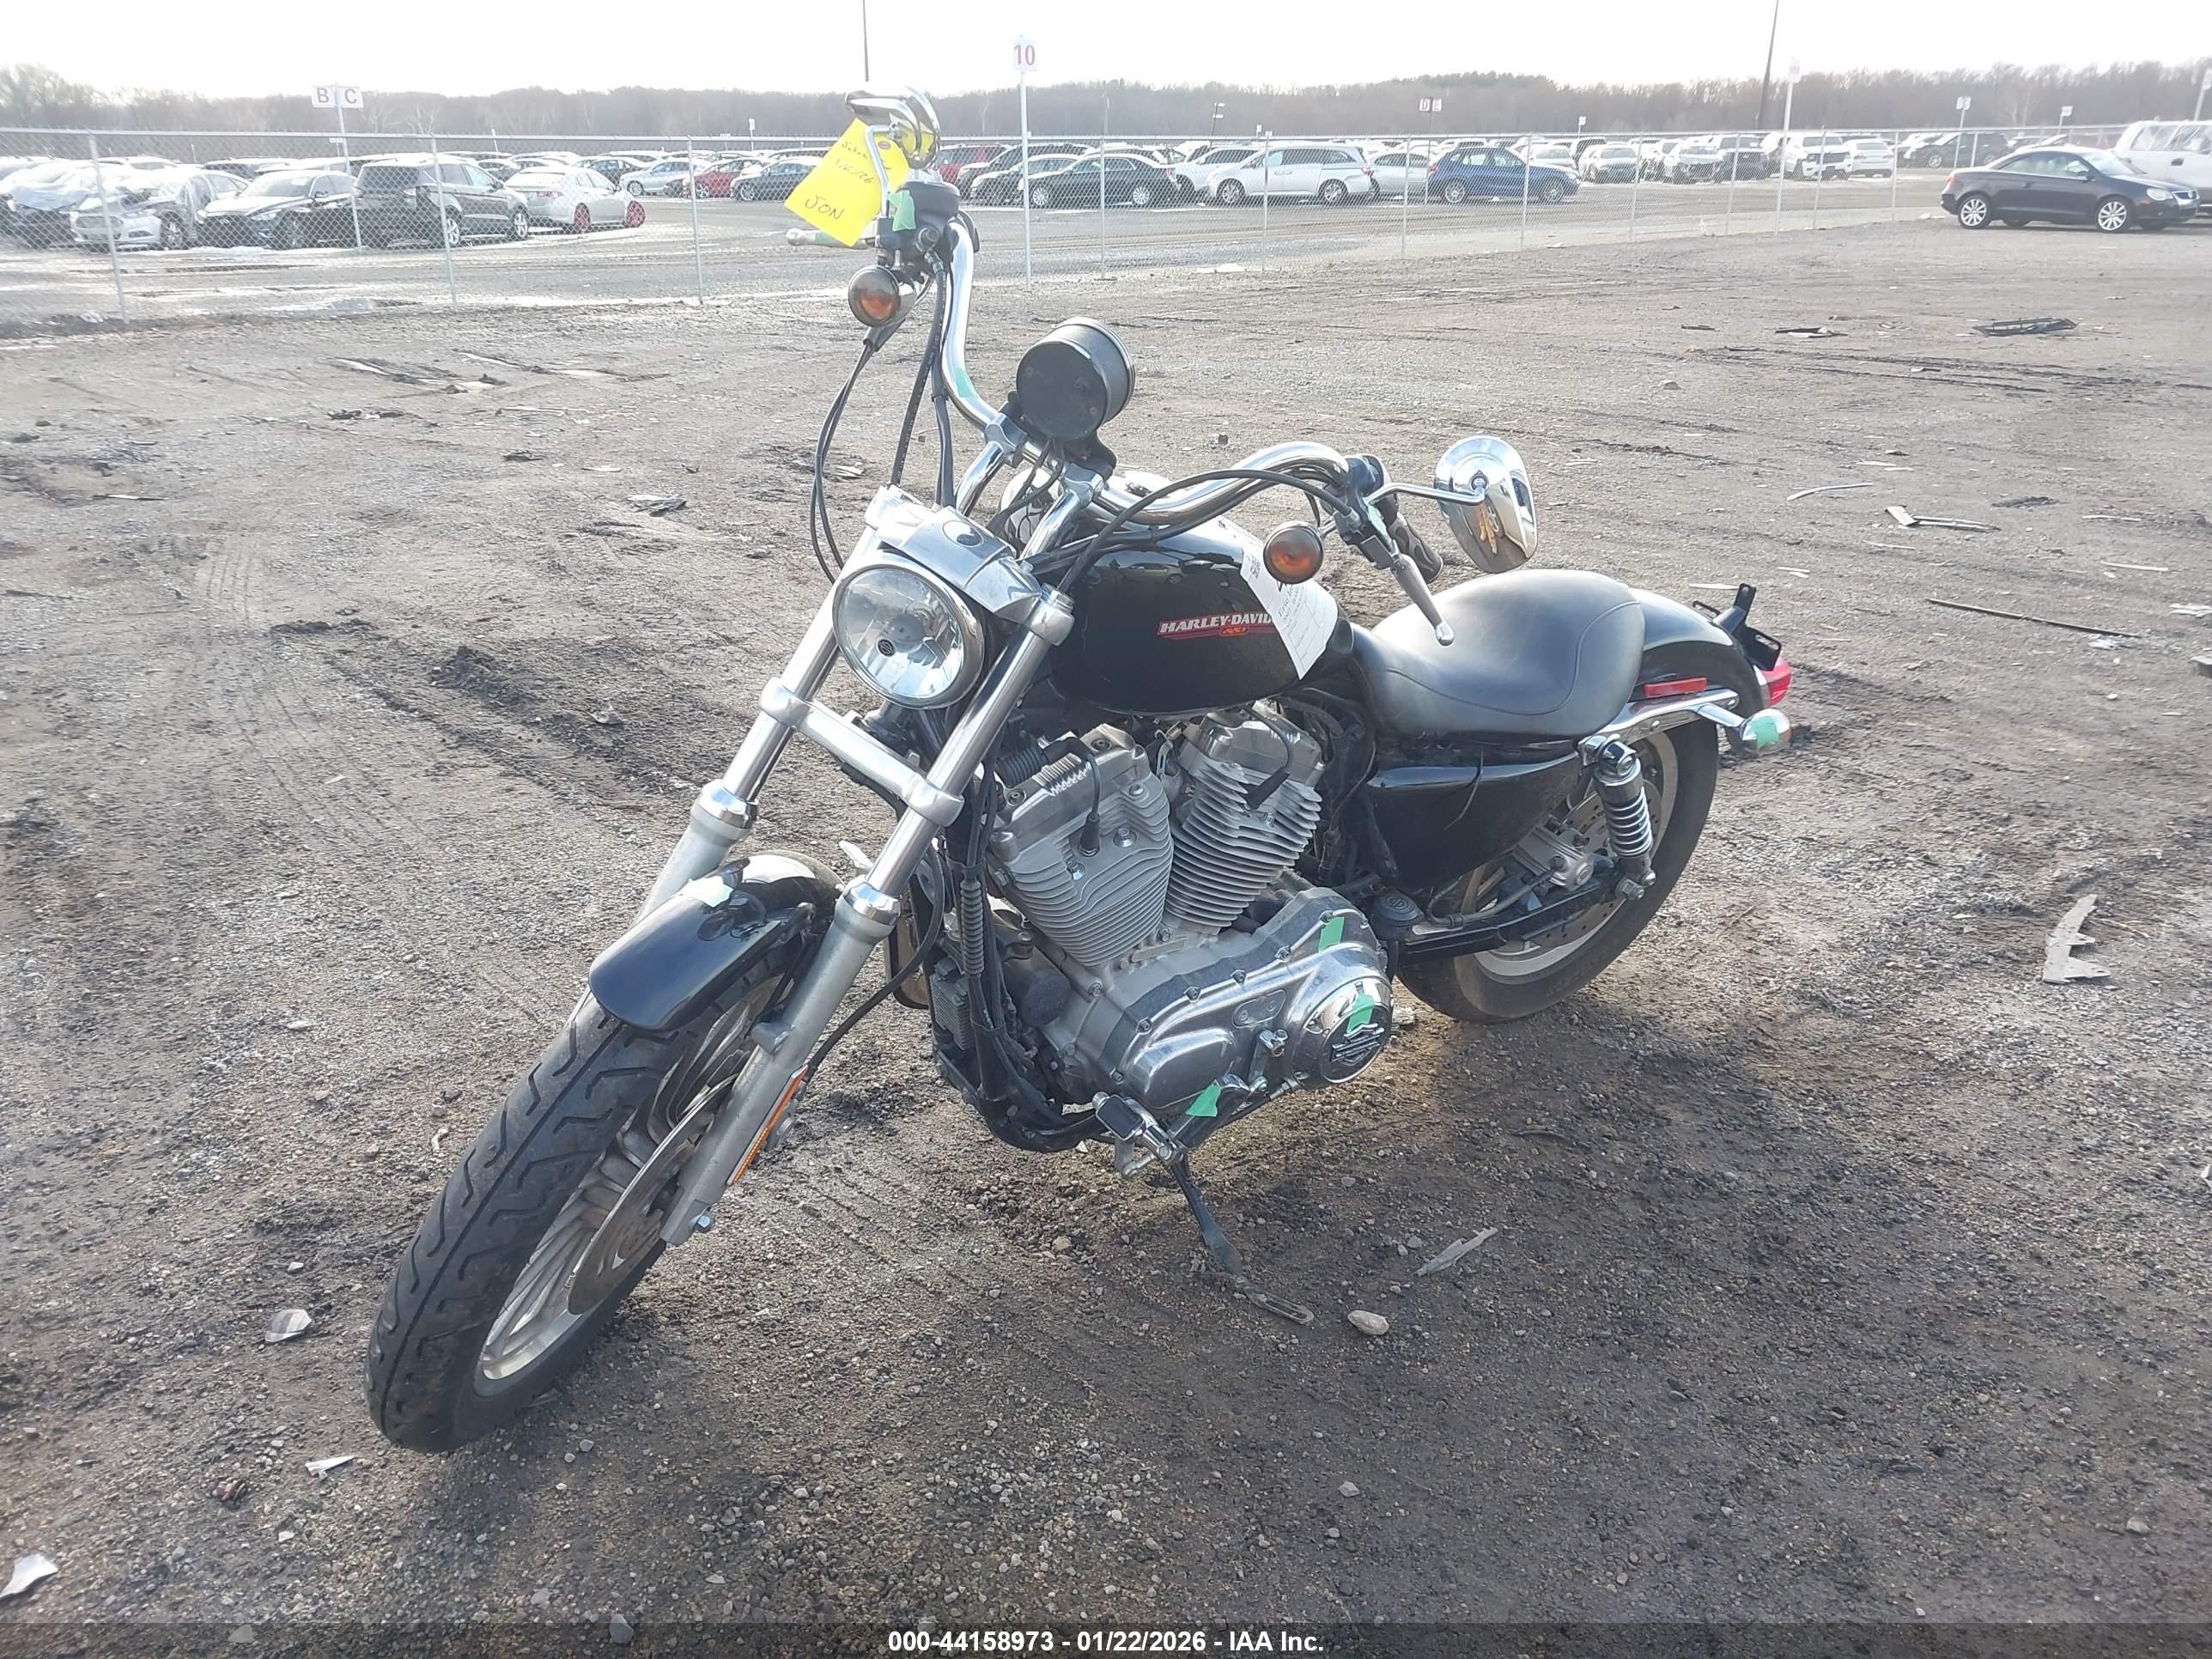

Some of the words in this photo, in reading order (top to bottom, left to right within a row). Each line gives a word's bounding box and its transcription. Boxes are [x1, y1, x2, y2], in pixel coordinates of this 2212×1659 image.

[1013, 44, 1036, 66] 10
[316, 88, 330, 103] B
[344, 88, 357, 104] C
[805, 195, 845, 220] JON
